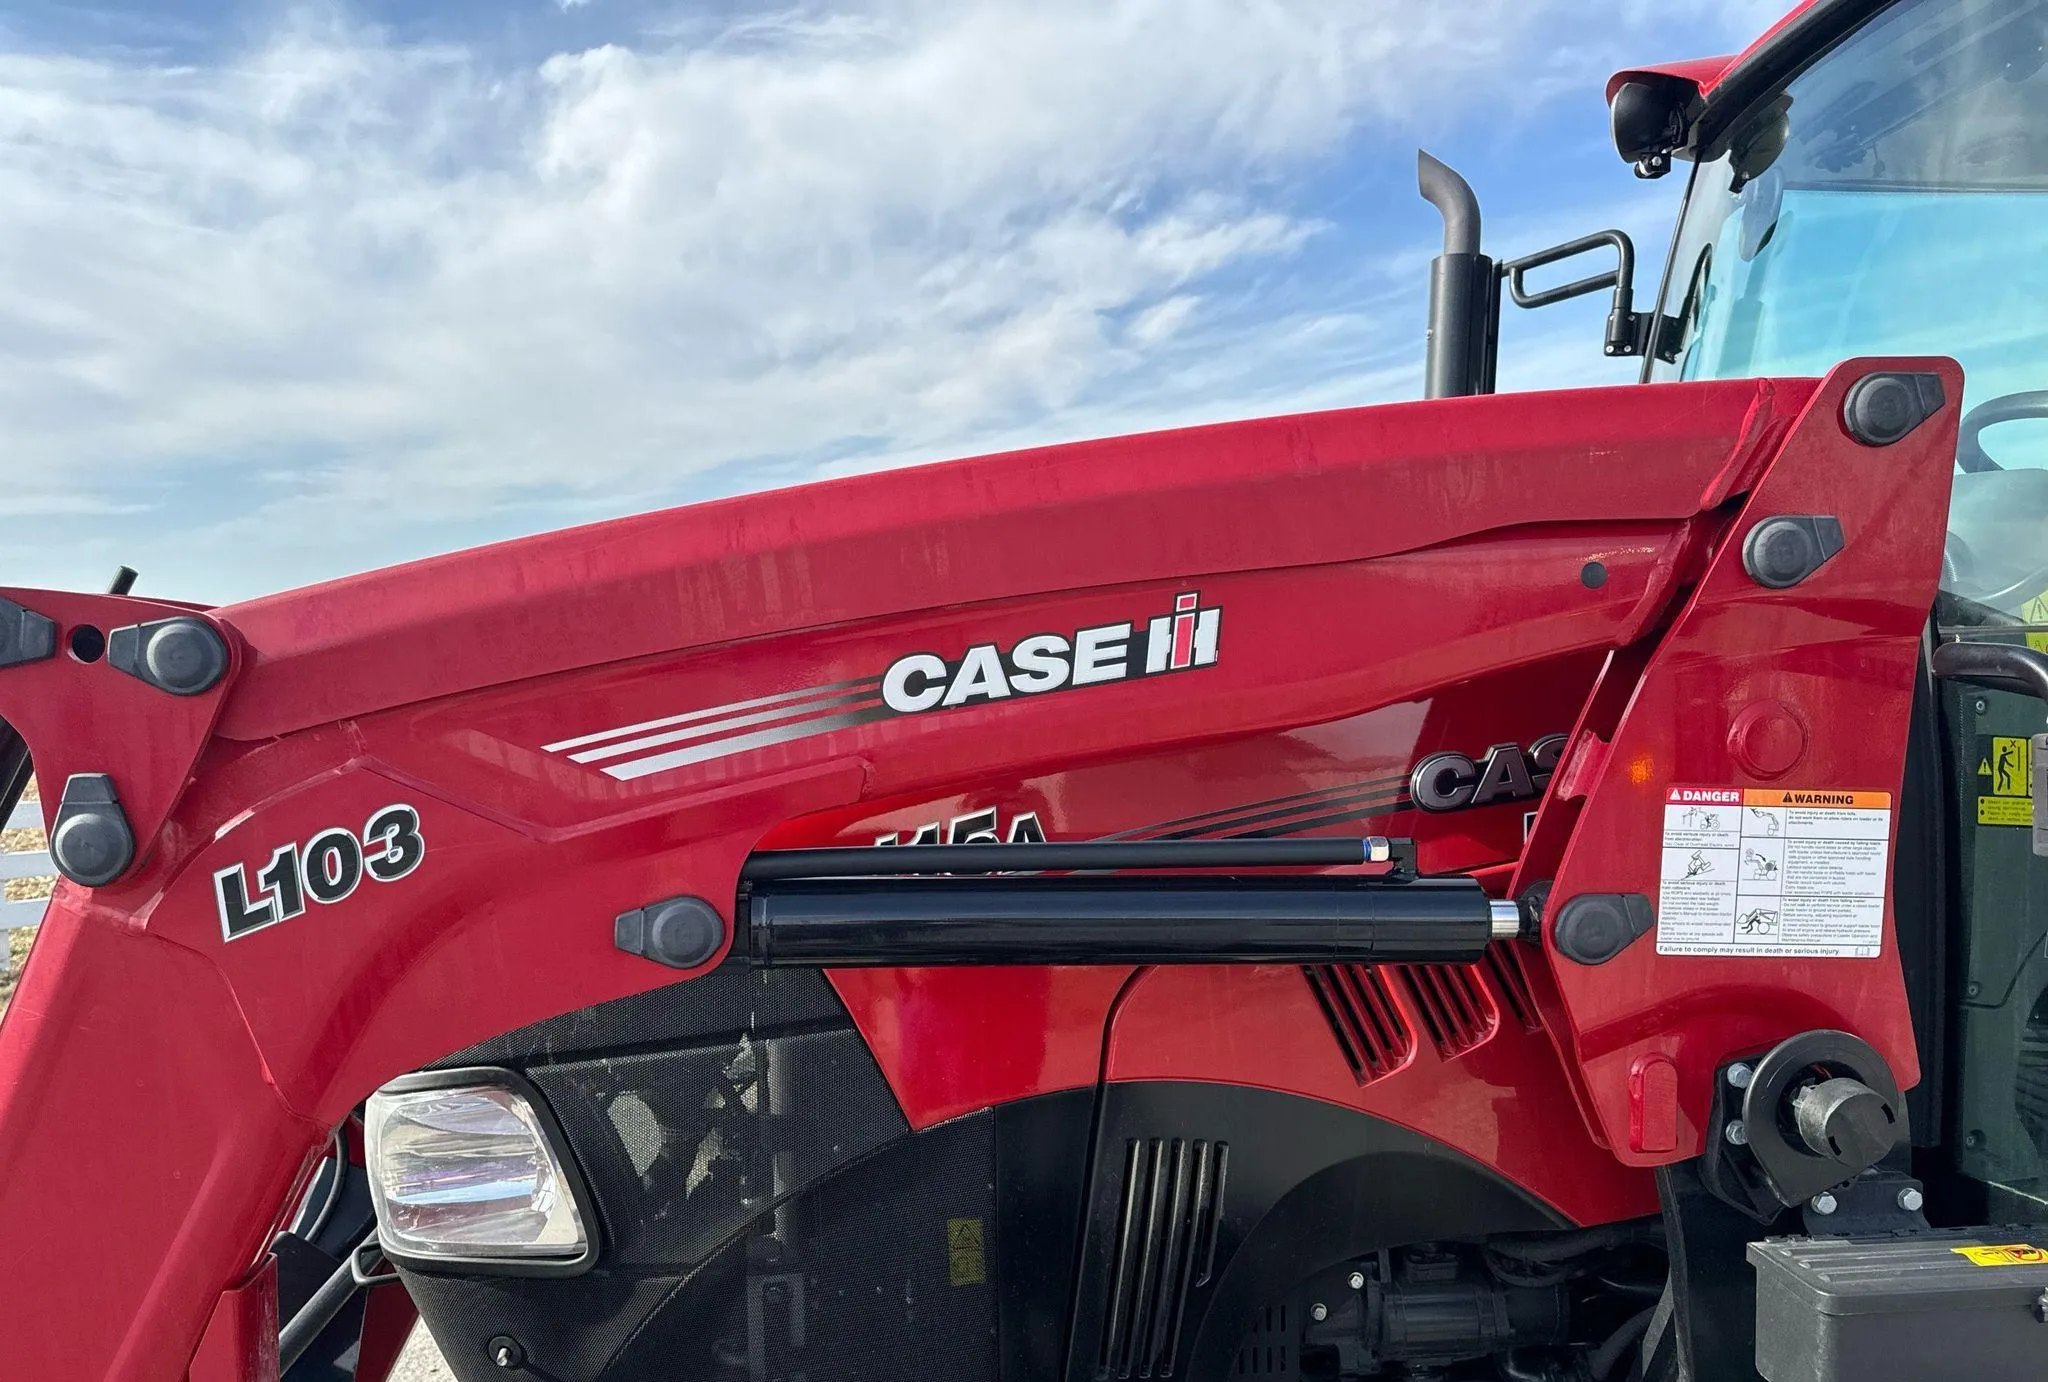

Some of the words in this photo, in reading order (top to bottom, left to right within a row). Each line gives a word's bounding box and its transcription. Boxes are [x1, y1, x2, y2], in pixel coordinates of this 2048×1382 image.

[882, 623, 1132, 713] CASE
[1410, 733, 1570, 813] CAS
[1683, 790, 1740, 803] DANGER
[1794, 793, 1854, 805] WARNING
[213, 802, 426, 943] L103
[1693, 946, 1718, 955] comply
[1720, 947, 1734, 956] may
